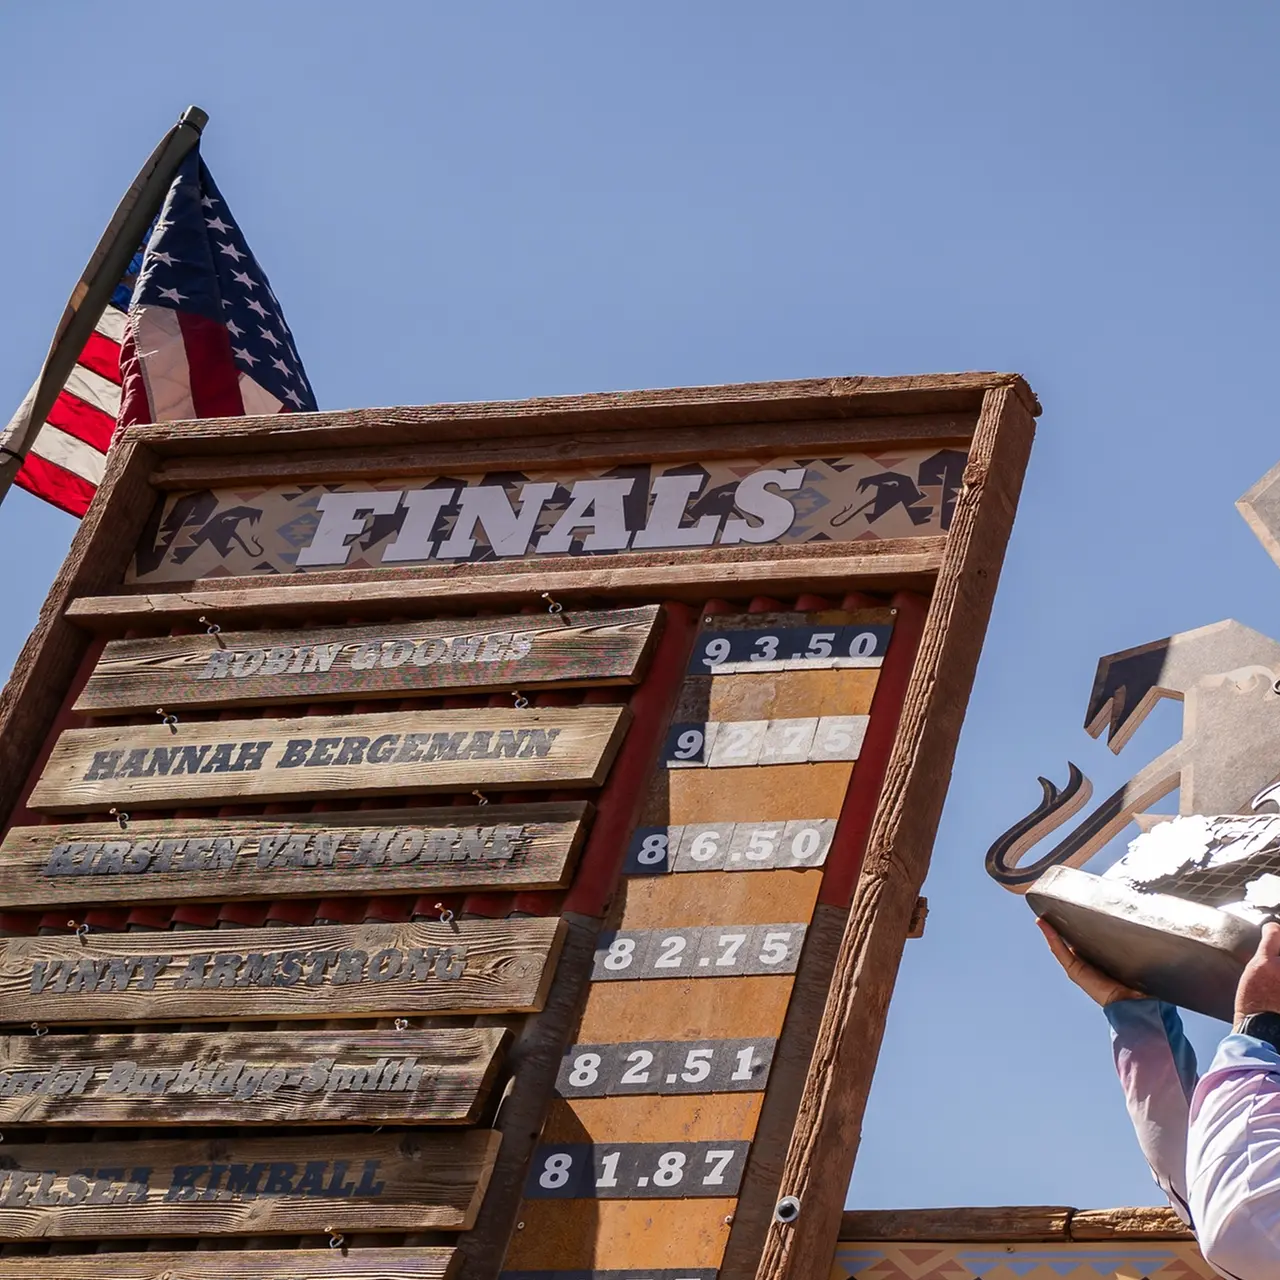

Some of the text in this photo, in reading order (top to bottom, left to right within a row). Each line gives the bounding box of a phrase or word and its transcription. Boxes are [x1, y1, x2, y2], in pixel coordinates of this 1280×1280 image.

[295, 467, 806, 566] FINALS
[197, 634, 533, 680] ROBIN GOOMES
[704, 630, 880, 669] 93.50
[82, 728, 562, 782] HANNAH BERGEMANN
[672, 722, 858, 763] 92.75
[42, 824, 526, 878] KIRSTEN VAN HORNE
[638, 826, 825, 866] 86.50
[30, 946, 468, 995] VINNY ARMSTRONG
[603, 932, 790, 972] 82.75
[102, 1056, 424, 1101] Burbidge-Smith
[567, 1046, 757, 1089] 82.51
[163, 1160, 387, 1202] KIMBALL
[539, 1149, 736, 1191] 81.87
